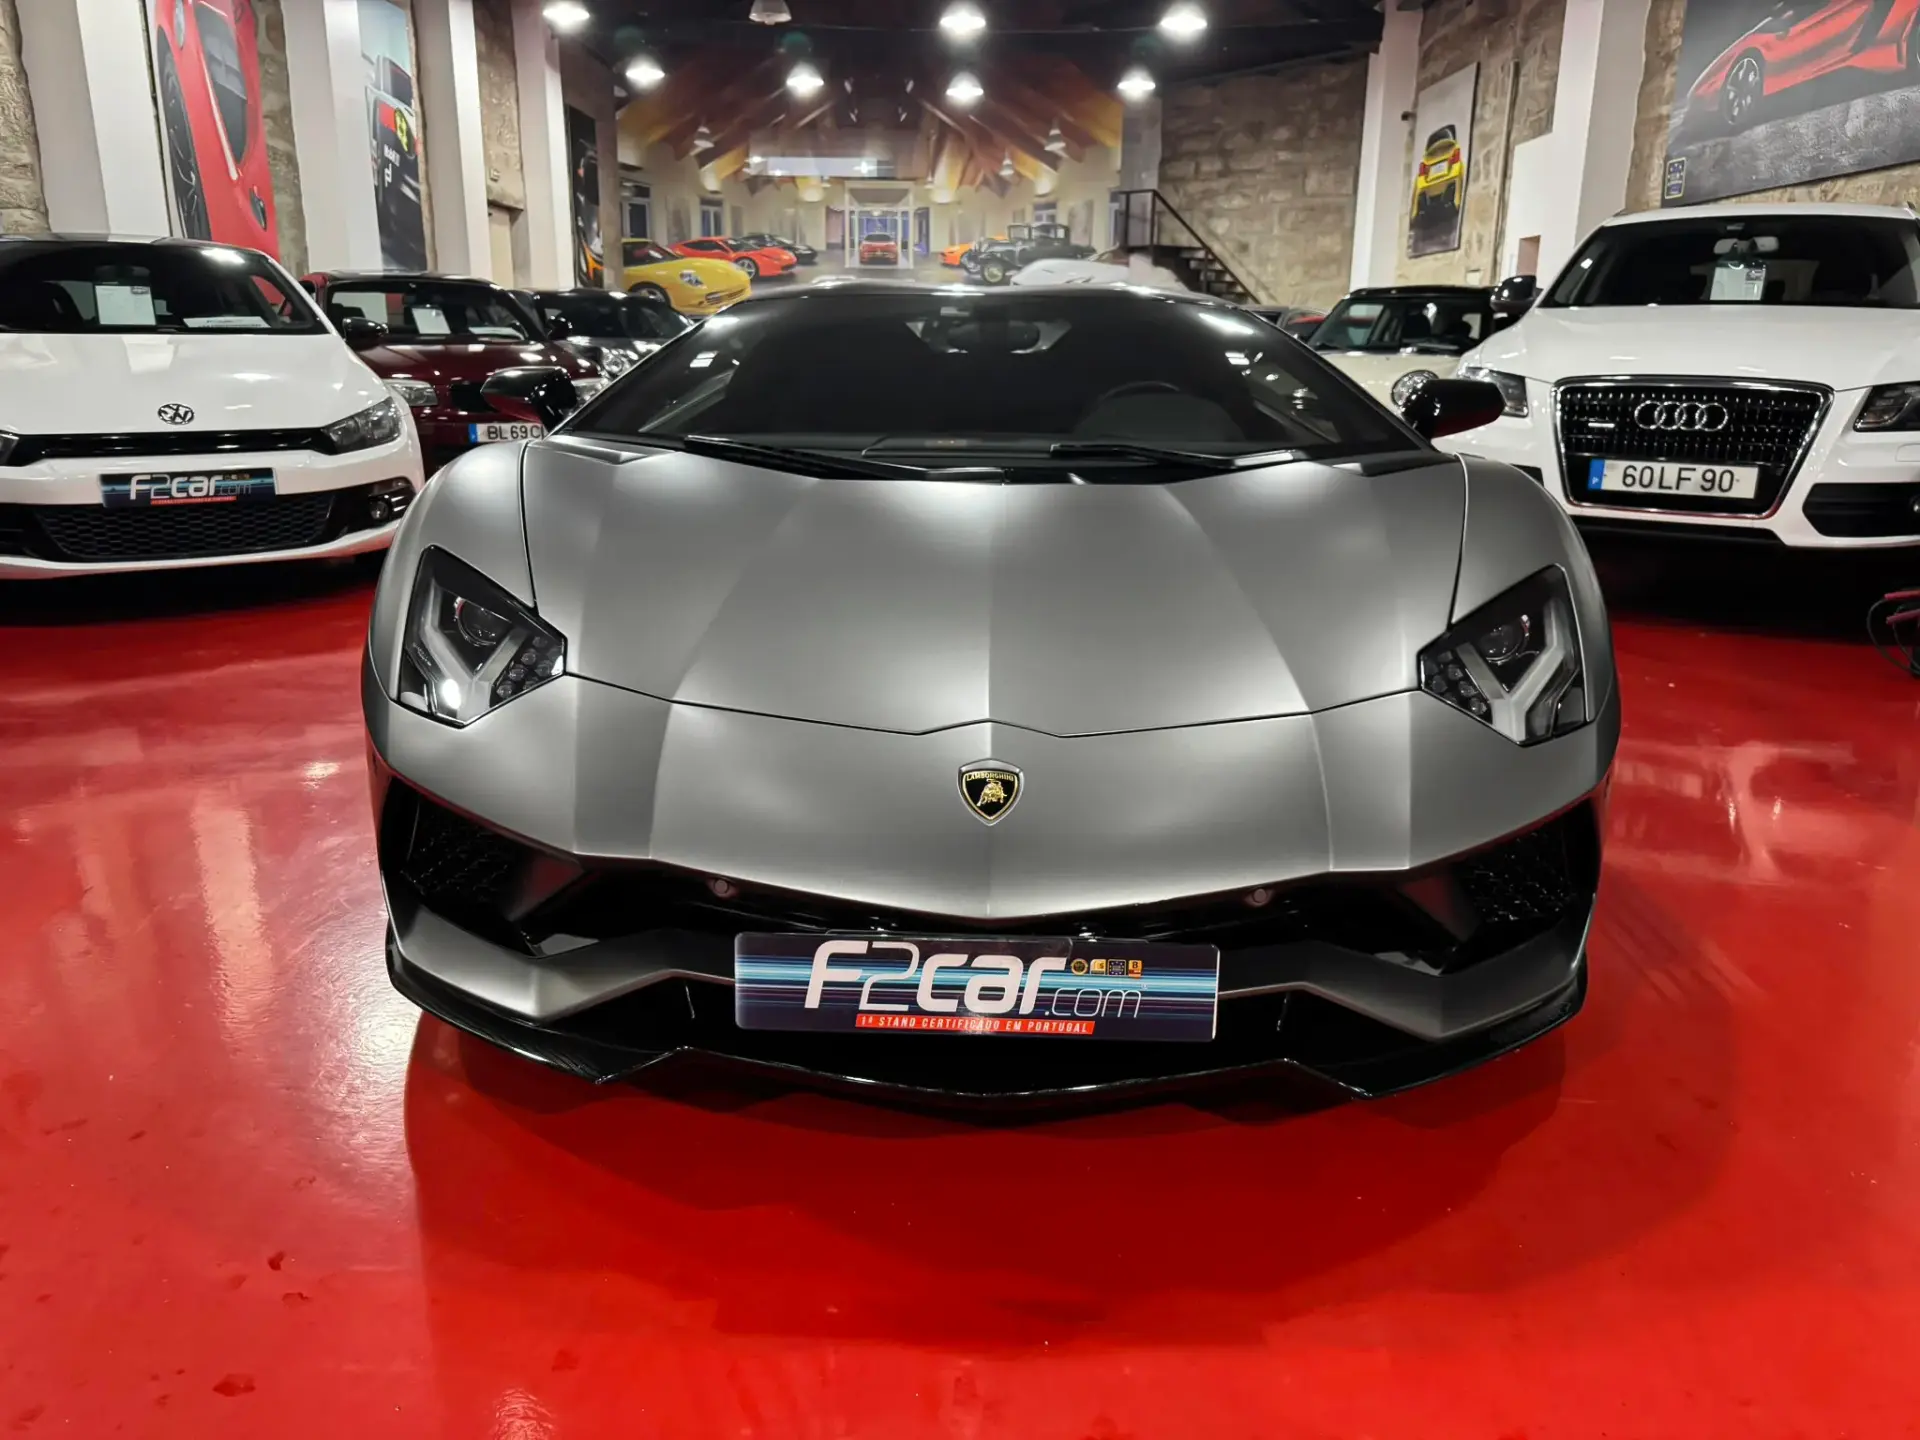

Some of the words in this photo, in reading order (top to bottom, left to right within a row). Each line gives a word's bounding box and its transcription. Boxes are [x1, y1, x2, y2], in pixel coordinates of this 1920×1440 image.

[965, 772, 1014, 781] LAMBORGHINI
[878, 1016, 916, 1027] STAND
[921, 1018, 1000, 1031] CERTIFICADO
[1005, 1020, 1022, 1031] EM
[1027, 1021, 1088, 1033] PORTUGAL
